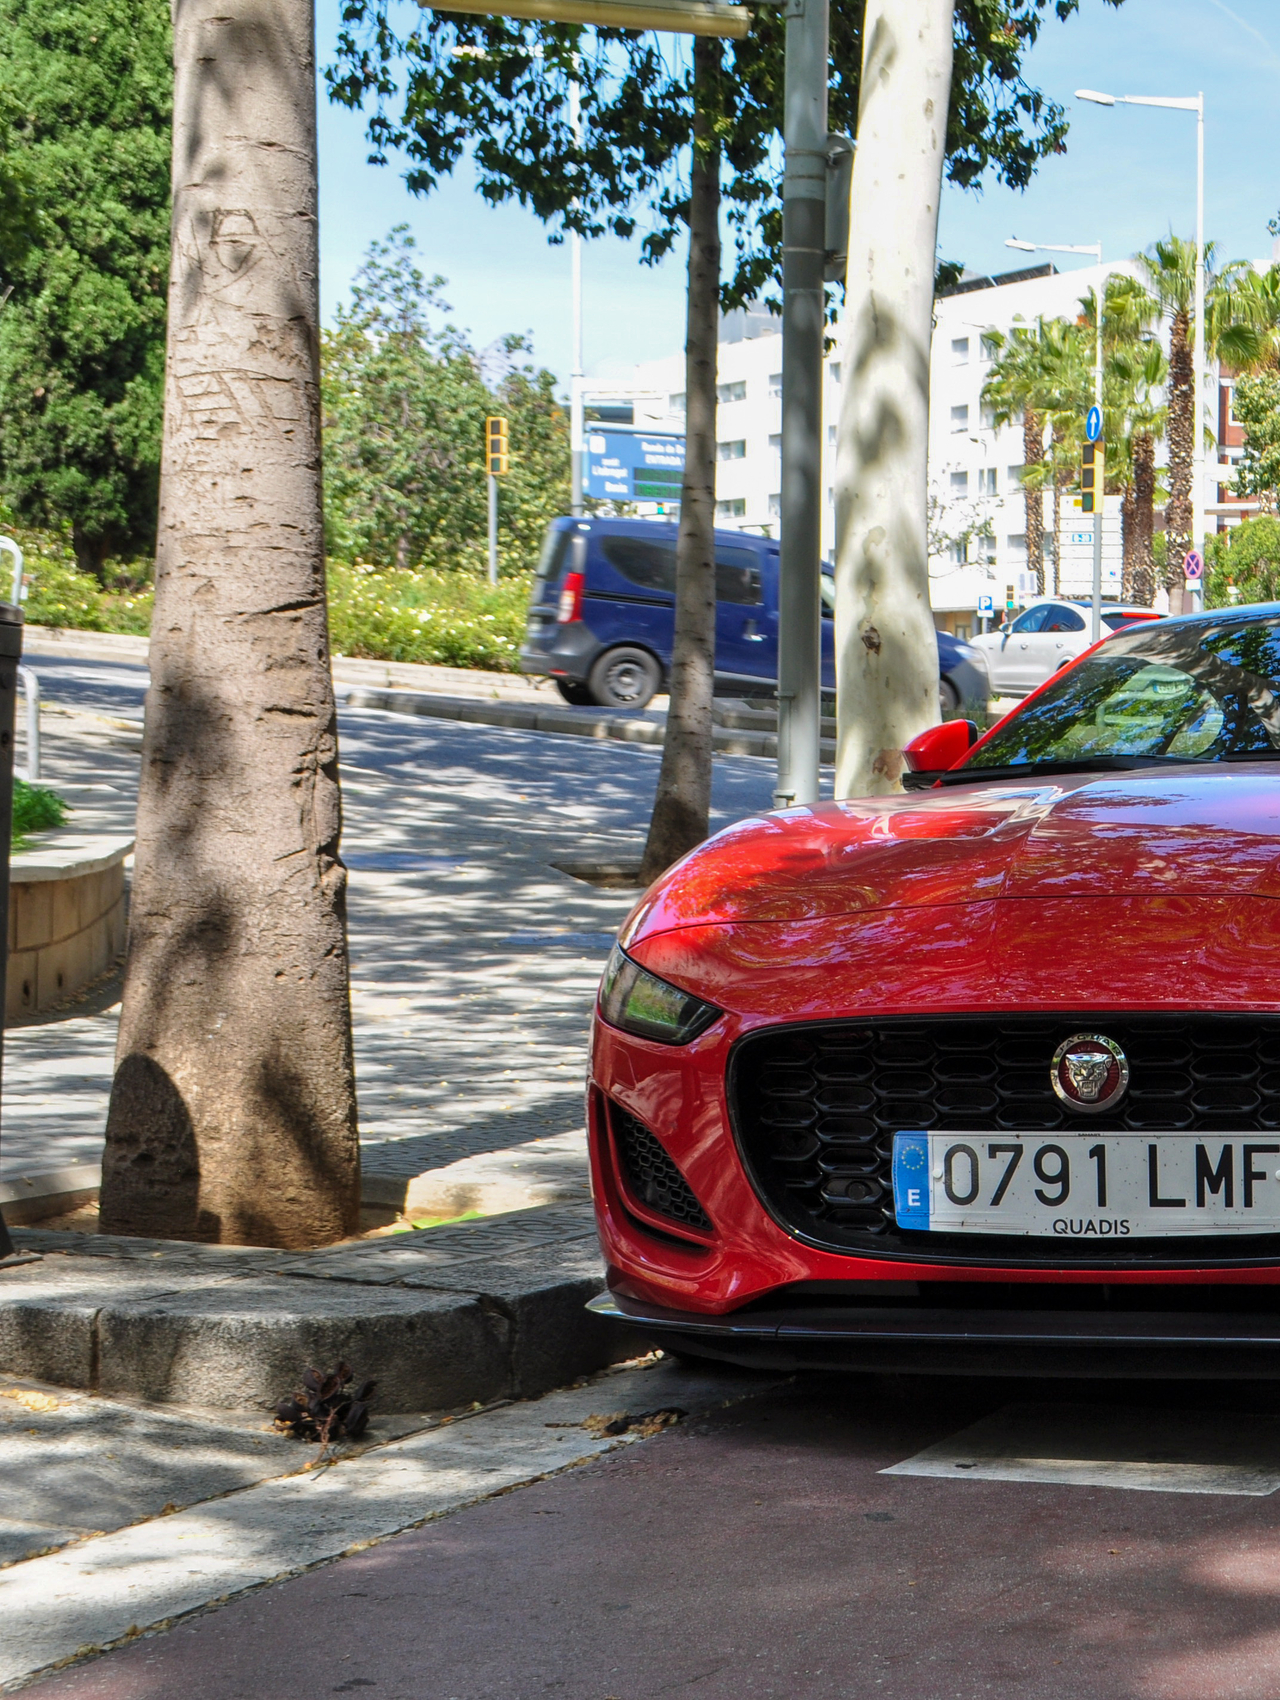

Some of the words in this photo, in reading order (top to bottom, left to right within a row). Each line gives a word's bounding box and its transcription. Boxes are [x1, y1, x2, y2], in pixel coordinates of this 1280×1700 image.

[981, 597, 990, 609] P
[1059, 1033, 1121, 1056] JAGUAR
[943, 1143, 1107, 1208] 0791
[1148, 1143, 1280, 1208] LMF
[908, 1189, 921, 1206] E
[1053, 1219, 1130, 1235] QUADIS
